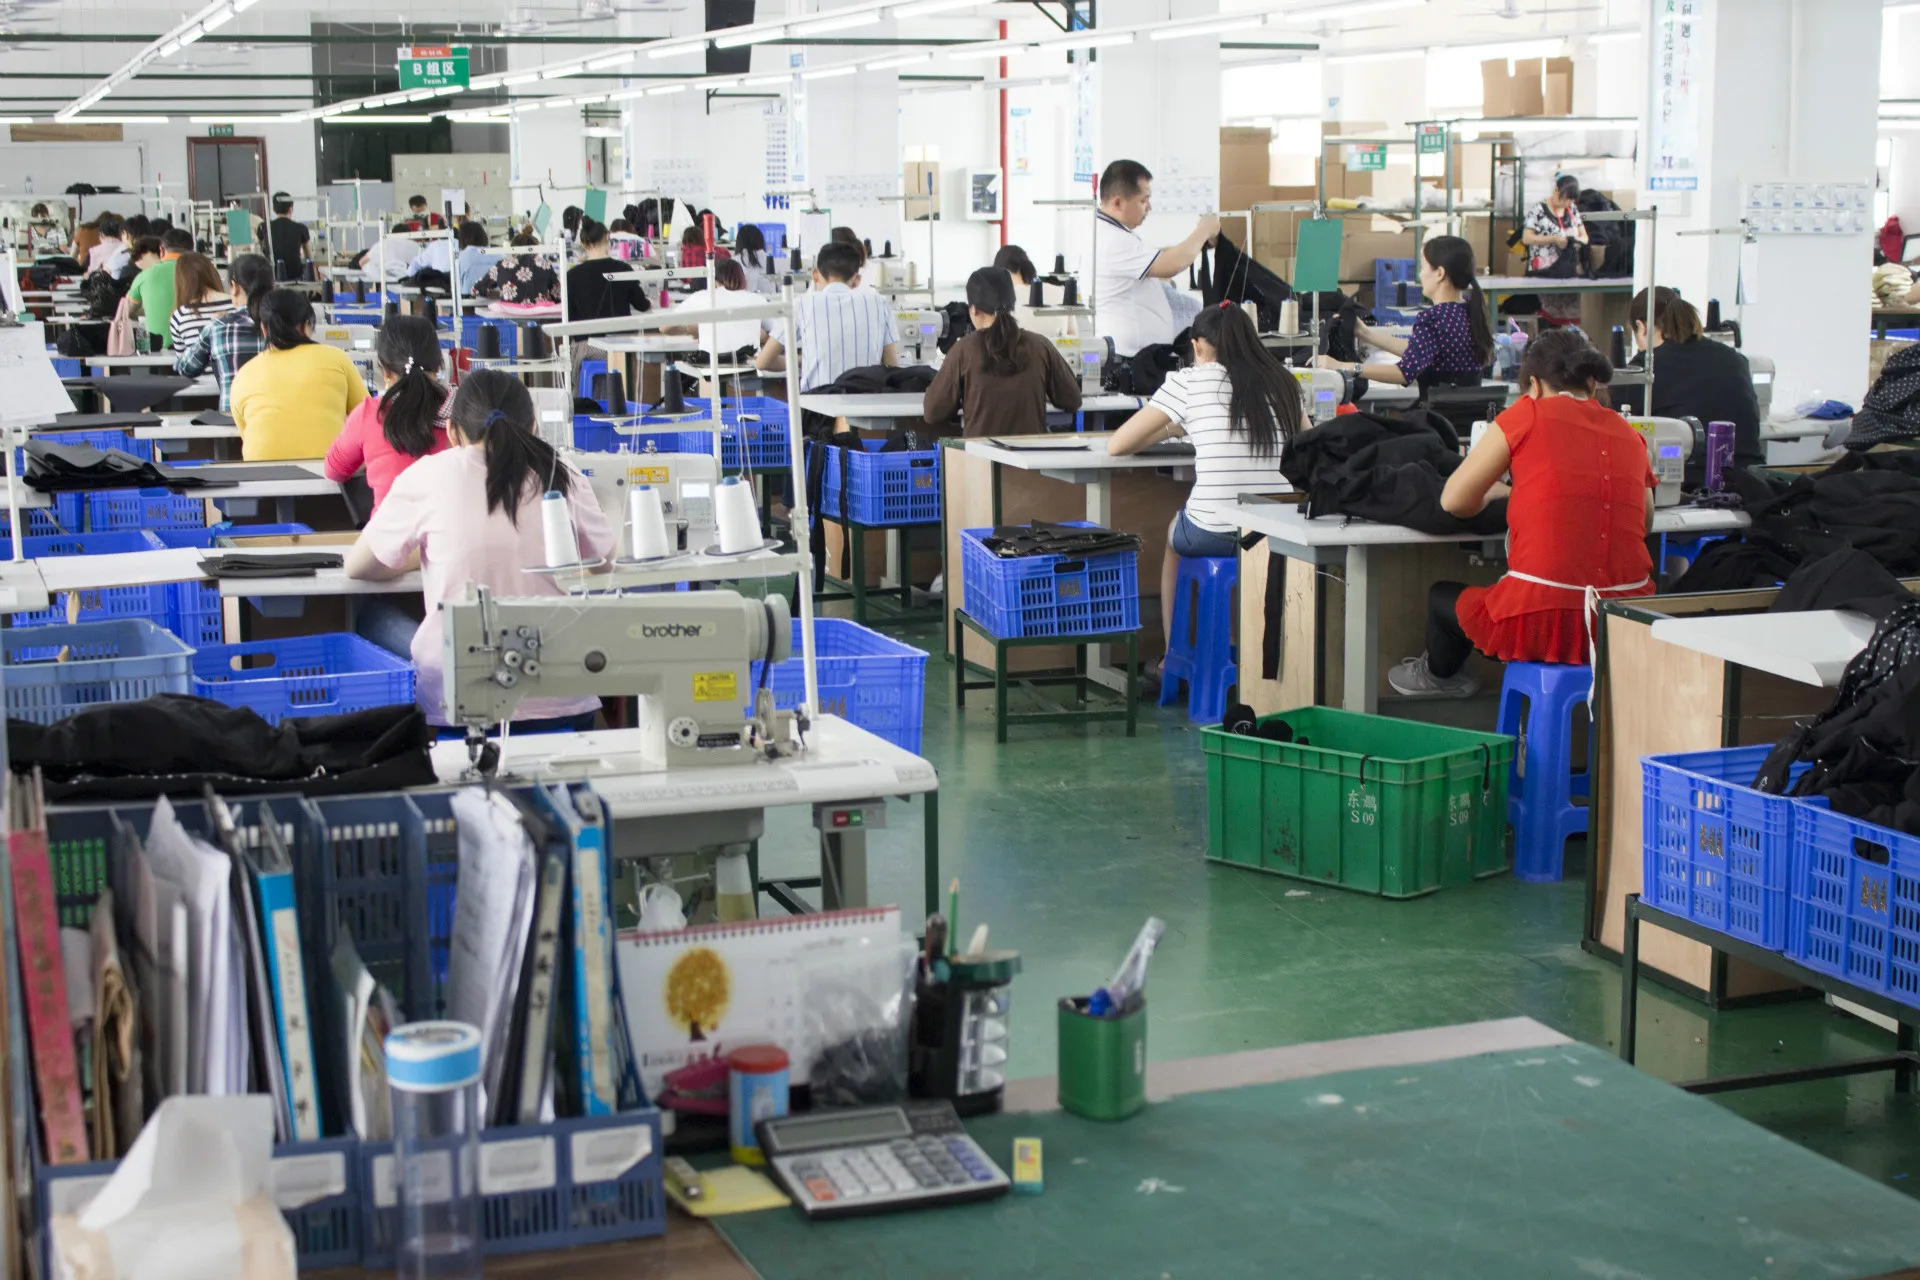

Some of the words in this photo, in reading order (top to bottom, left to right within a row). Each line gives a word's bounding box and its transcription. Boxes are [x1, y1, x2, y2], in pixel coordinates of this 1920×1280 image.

[413, 63, 423, 76] B
[426, 61, 456, 76] 组区
[423, 77, 442, 85] Team
[642, 623, 702, 638] brother
[1351, 810, 1360, 823] S
[1362, 811, 1375, 826] 09
[1449, 812, 1457, 827] S
